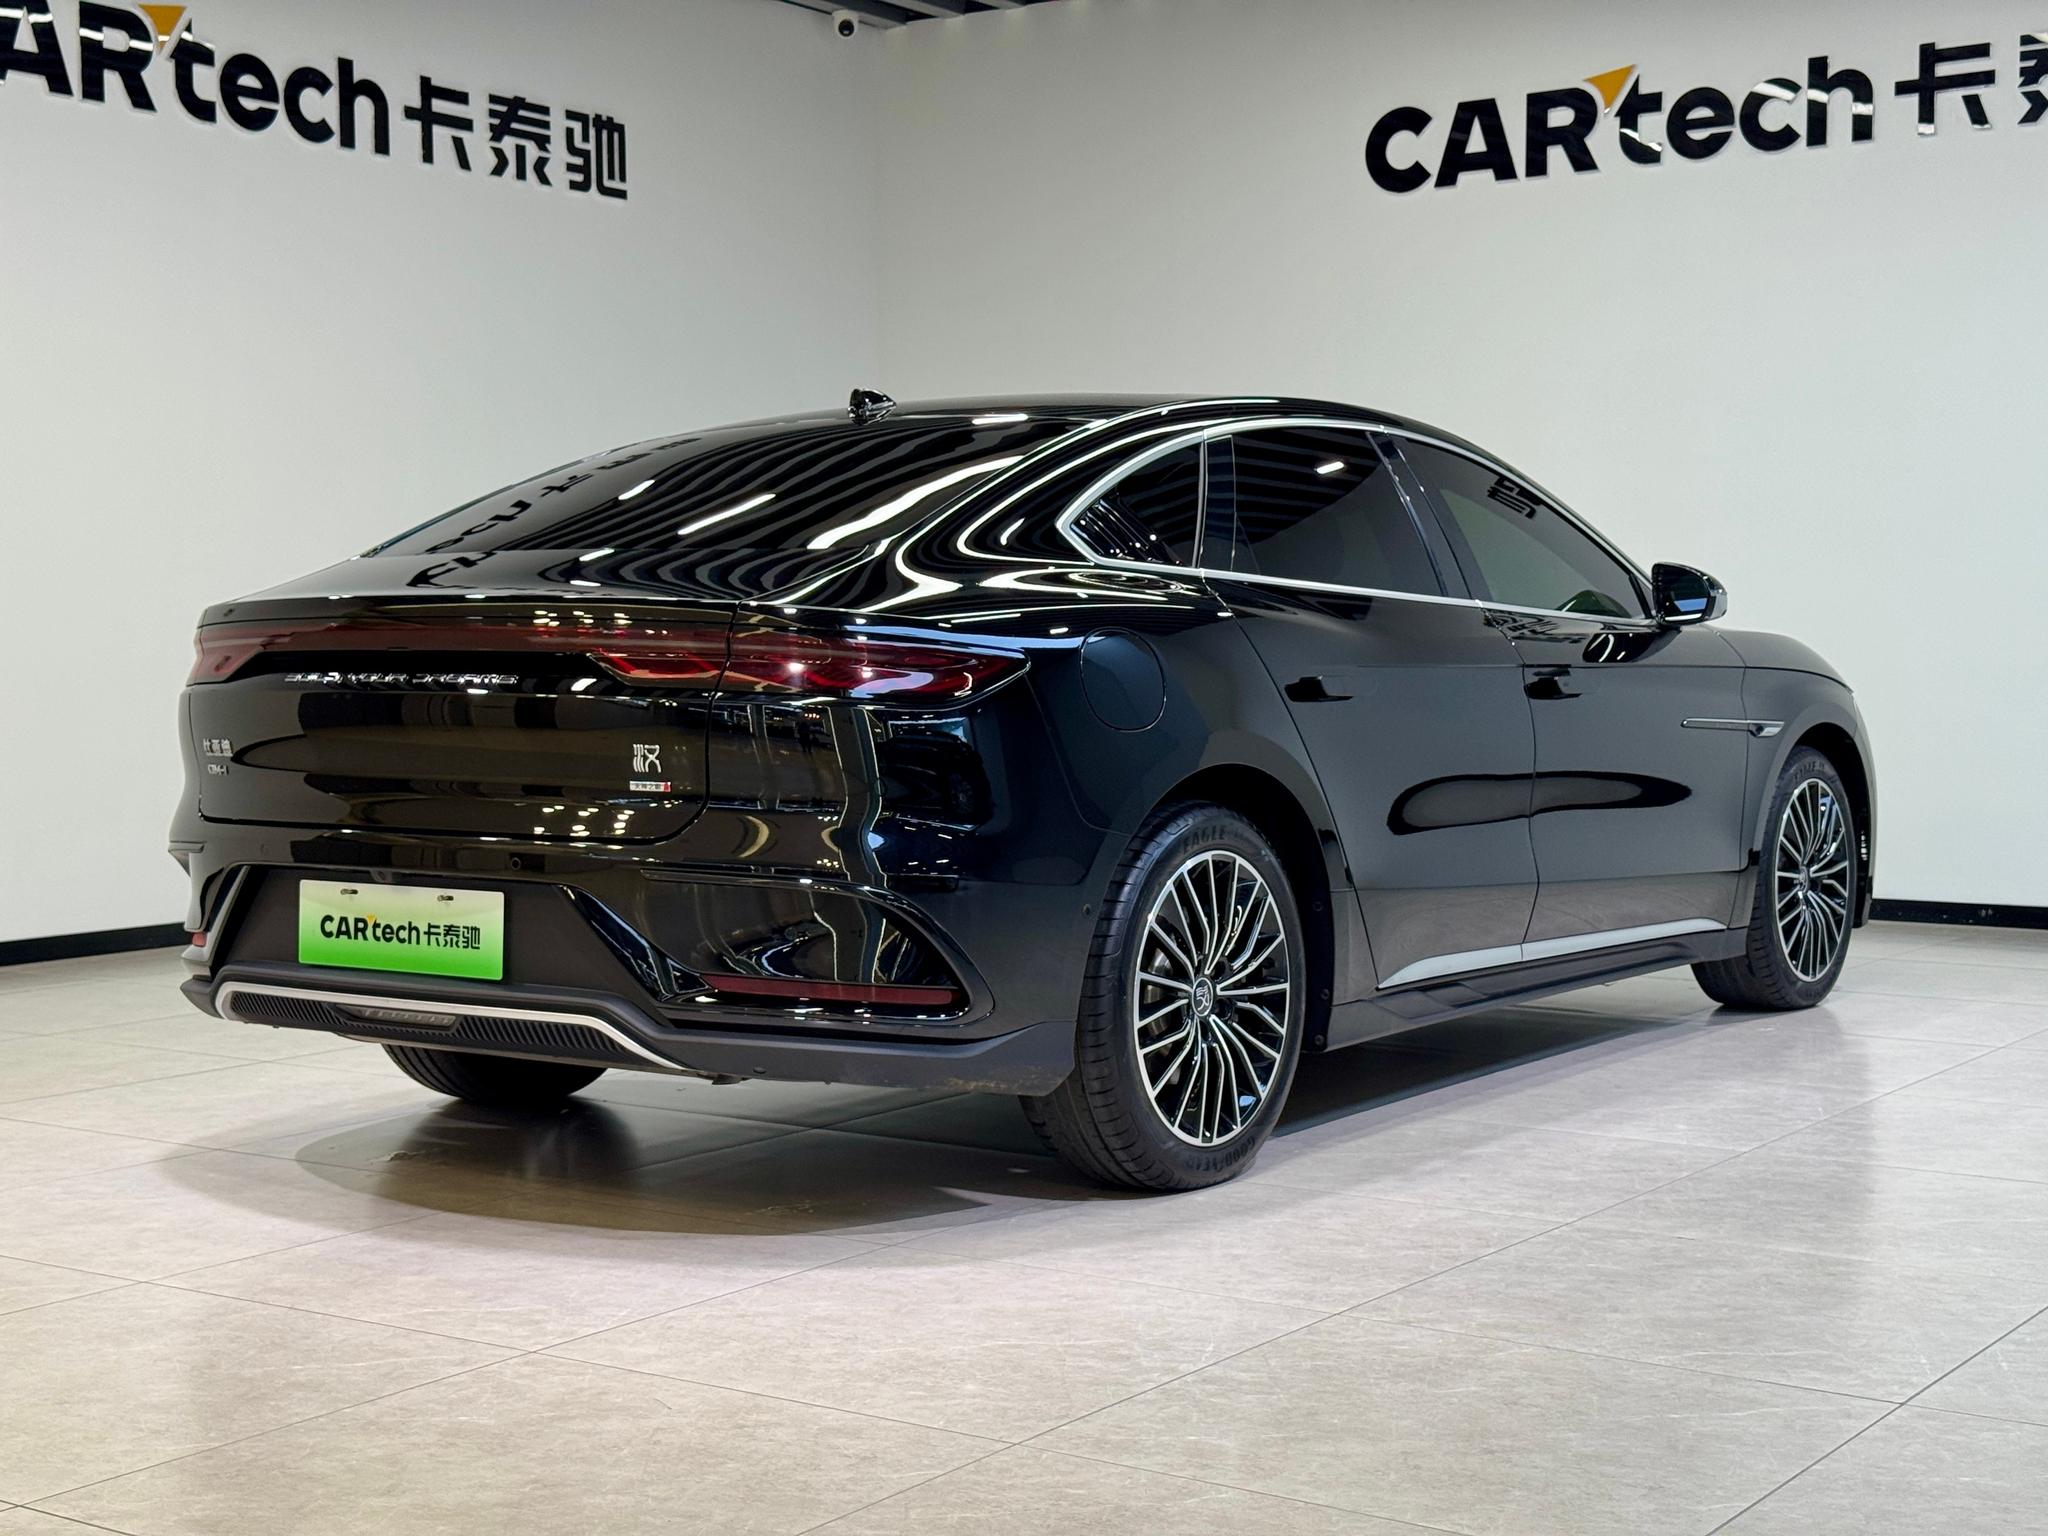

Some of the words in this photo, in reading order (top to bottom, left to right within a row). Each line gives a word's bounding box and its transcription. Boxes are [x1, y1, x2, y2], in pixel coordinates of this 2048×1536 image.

[403, 75, 628, 200] 卡泰驰
[1365, 55, 1875, 194] CARtech
[348, 672, 409, 684] YOUR
[412, 673, 519, 684] DREAMS
[632, 743, 662, 773] 汉
[320, 914, 421, 946] CARtech
[423, 922, 481, 950] 卡泰驰
